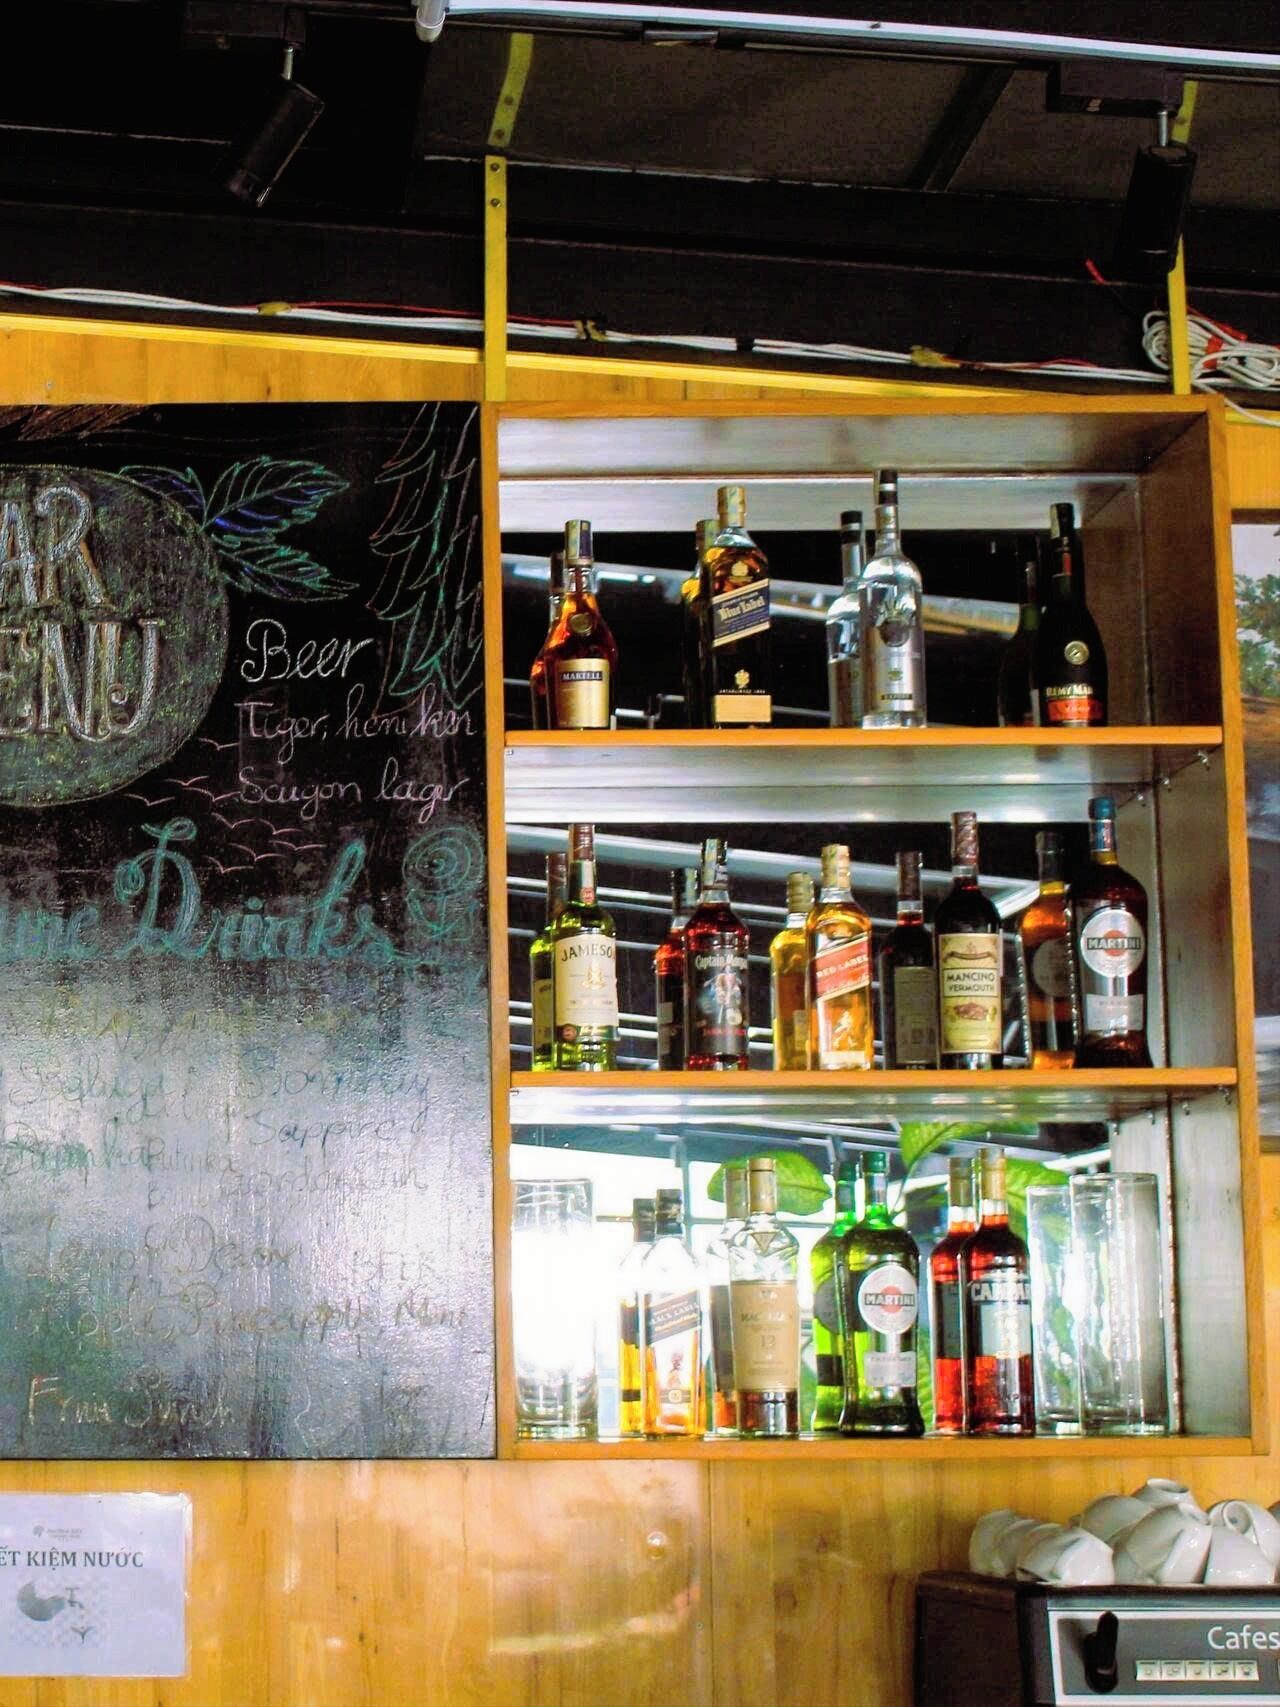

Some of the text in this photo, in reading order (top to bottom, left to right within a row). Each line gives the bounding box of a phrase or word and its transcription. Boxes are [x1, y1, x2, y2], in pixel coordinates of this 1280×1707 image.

[241, 618, 375, 683] Beer
[563, 672, 602, 681] MARTELL
[239, 766, 362, 821] Saigon
[1088, 938, 1141, 950] MARTINI
[816, 954, 869, 979] RED LABEL
[947, 972, 994, 983] MANCINO
[949, 983, 994, 993] VERMOUTH
[865, 1294, 915, 1305] MARTINI
[27, 1547, 78, 1571] KIỆM
[82, 1547, 144, 1568] NƯỚC
